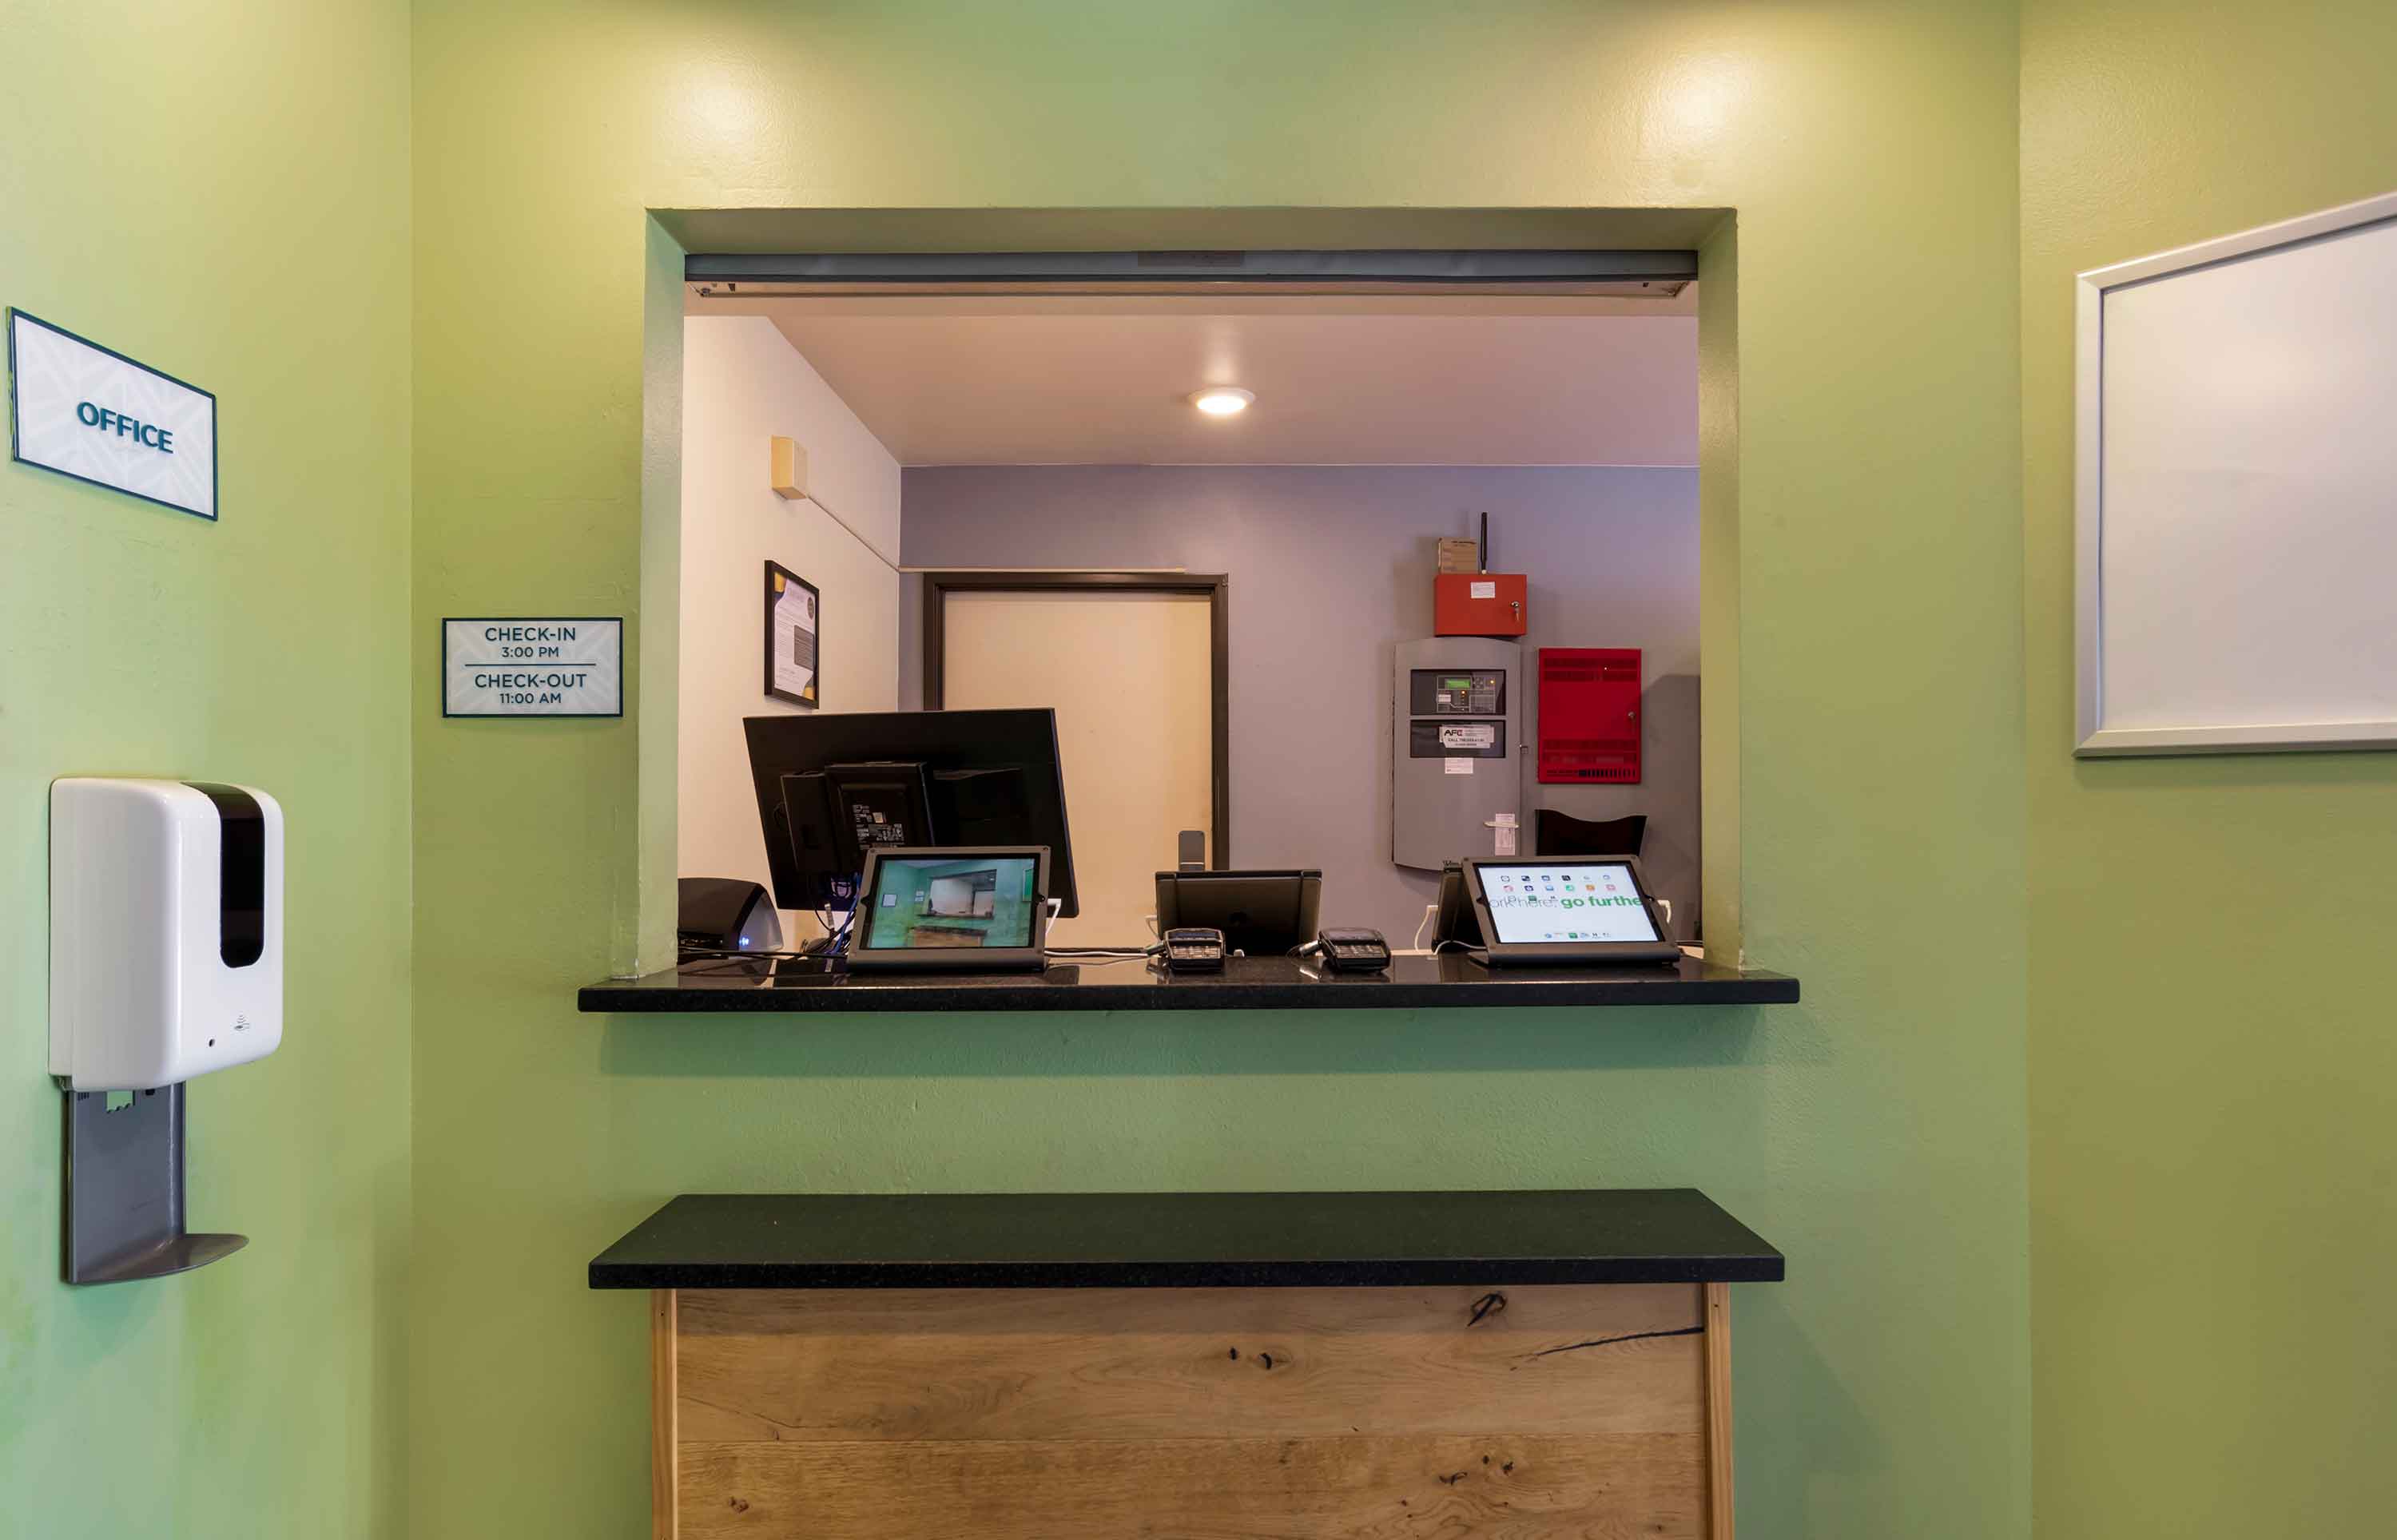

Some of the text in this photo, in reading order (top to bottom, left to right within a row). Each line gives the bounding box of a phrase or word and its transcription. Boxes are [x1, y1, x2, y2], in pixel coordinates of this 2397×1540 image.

[77, 402, 173, 454] OFFICE
[485, 627, 576, 641] CHECK-IN
[502, 646, 559, 657] 3:00 PM
[475, 673, 587, 688] CHECK-OUT
[499, 693, 562, 704] 11:00 AM
[1560, 898, 1584, 909] go
[1588, 895, 1642, 907] furthe
